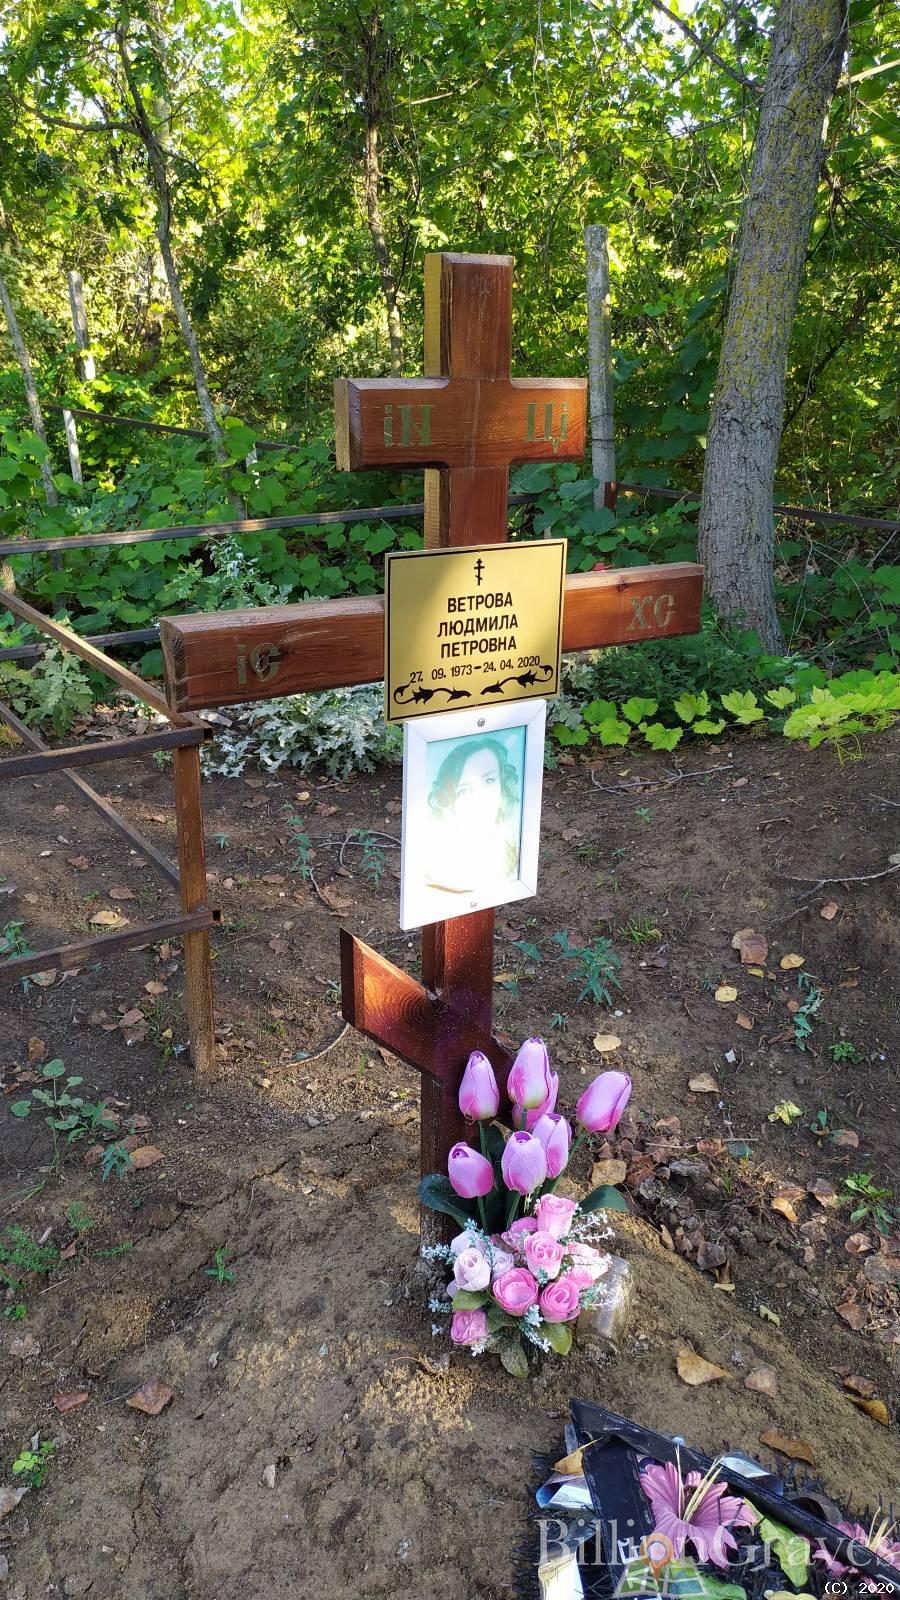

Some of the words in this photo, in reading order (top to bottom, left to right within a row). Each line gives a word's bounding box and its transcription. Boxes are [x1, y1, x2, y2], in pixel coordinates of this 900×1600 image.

[447, 591, 513, 613] ВЕТРОВА
[437, 613, 519, 638] ЛЮДМИЛА
[440, 635, 517, 659] ПЕТРОВНА
[431, 668, 446, 681] 09.
[500, 658, 514, 670] 04.
[517, 655, 540, 668] 2020
